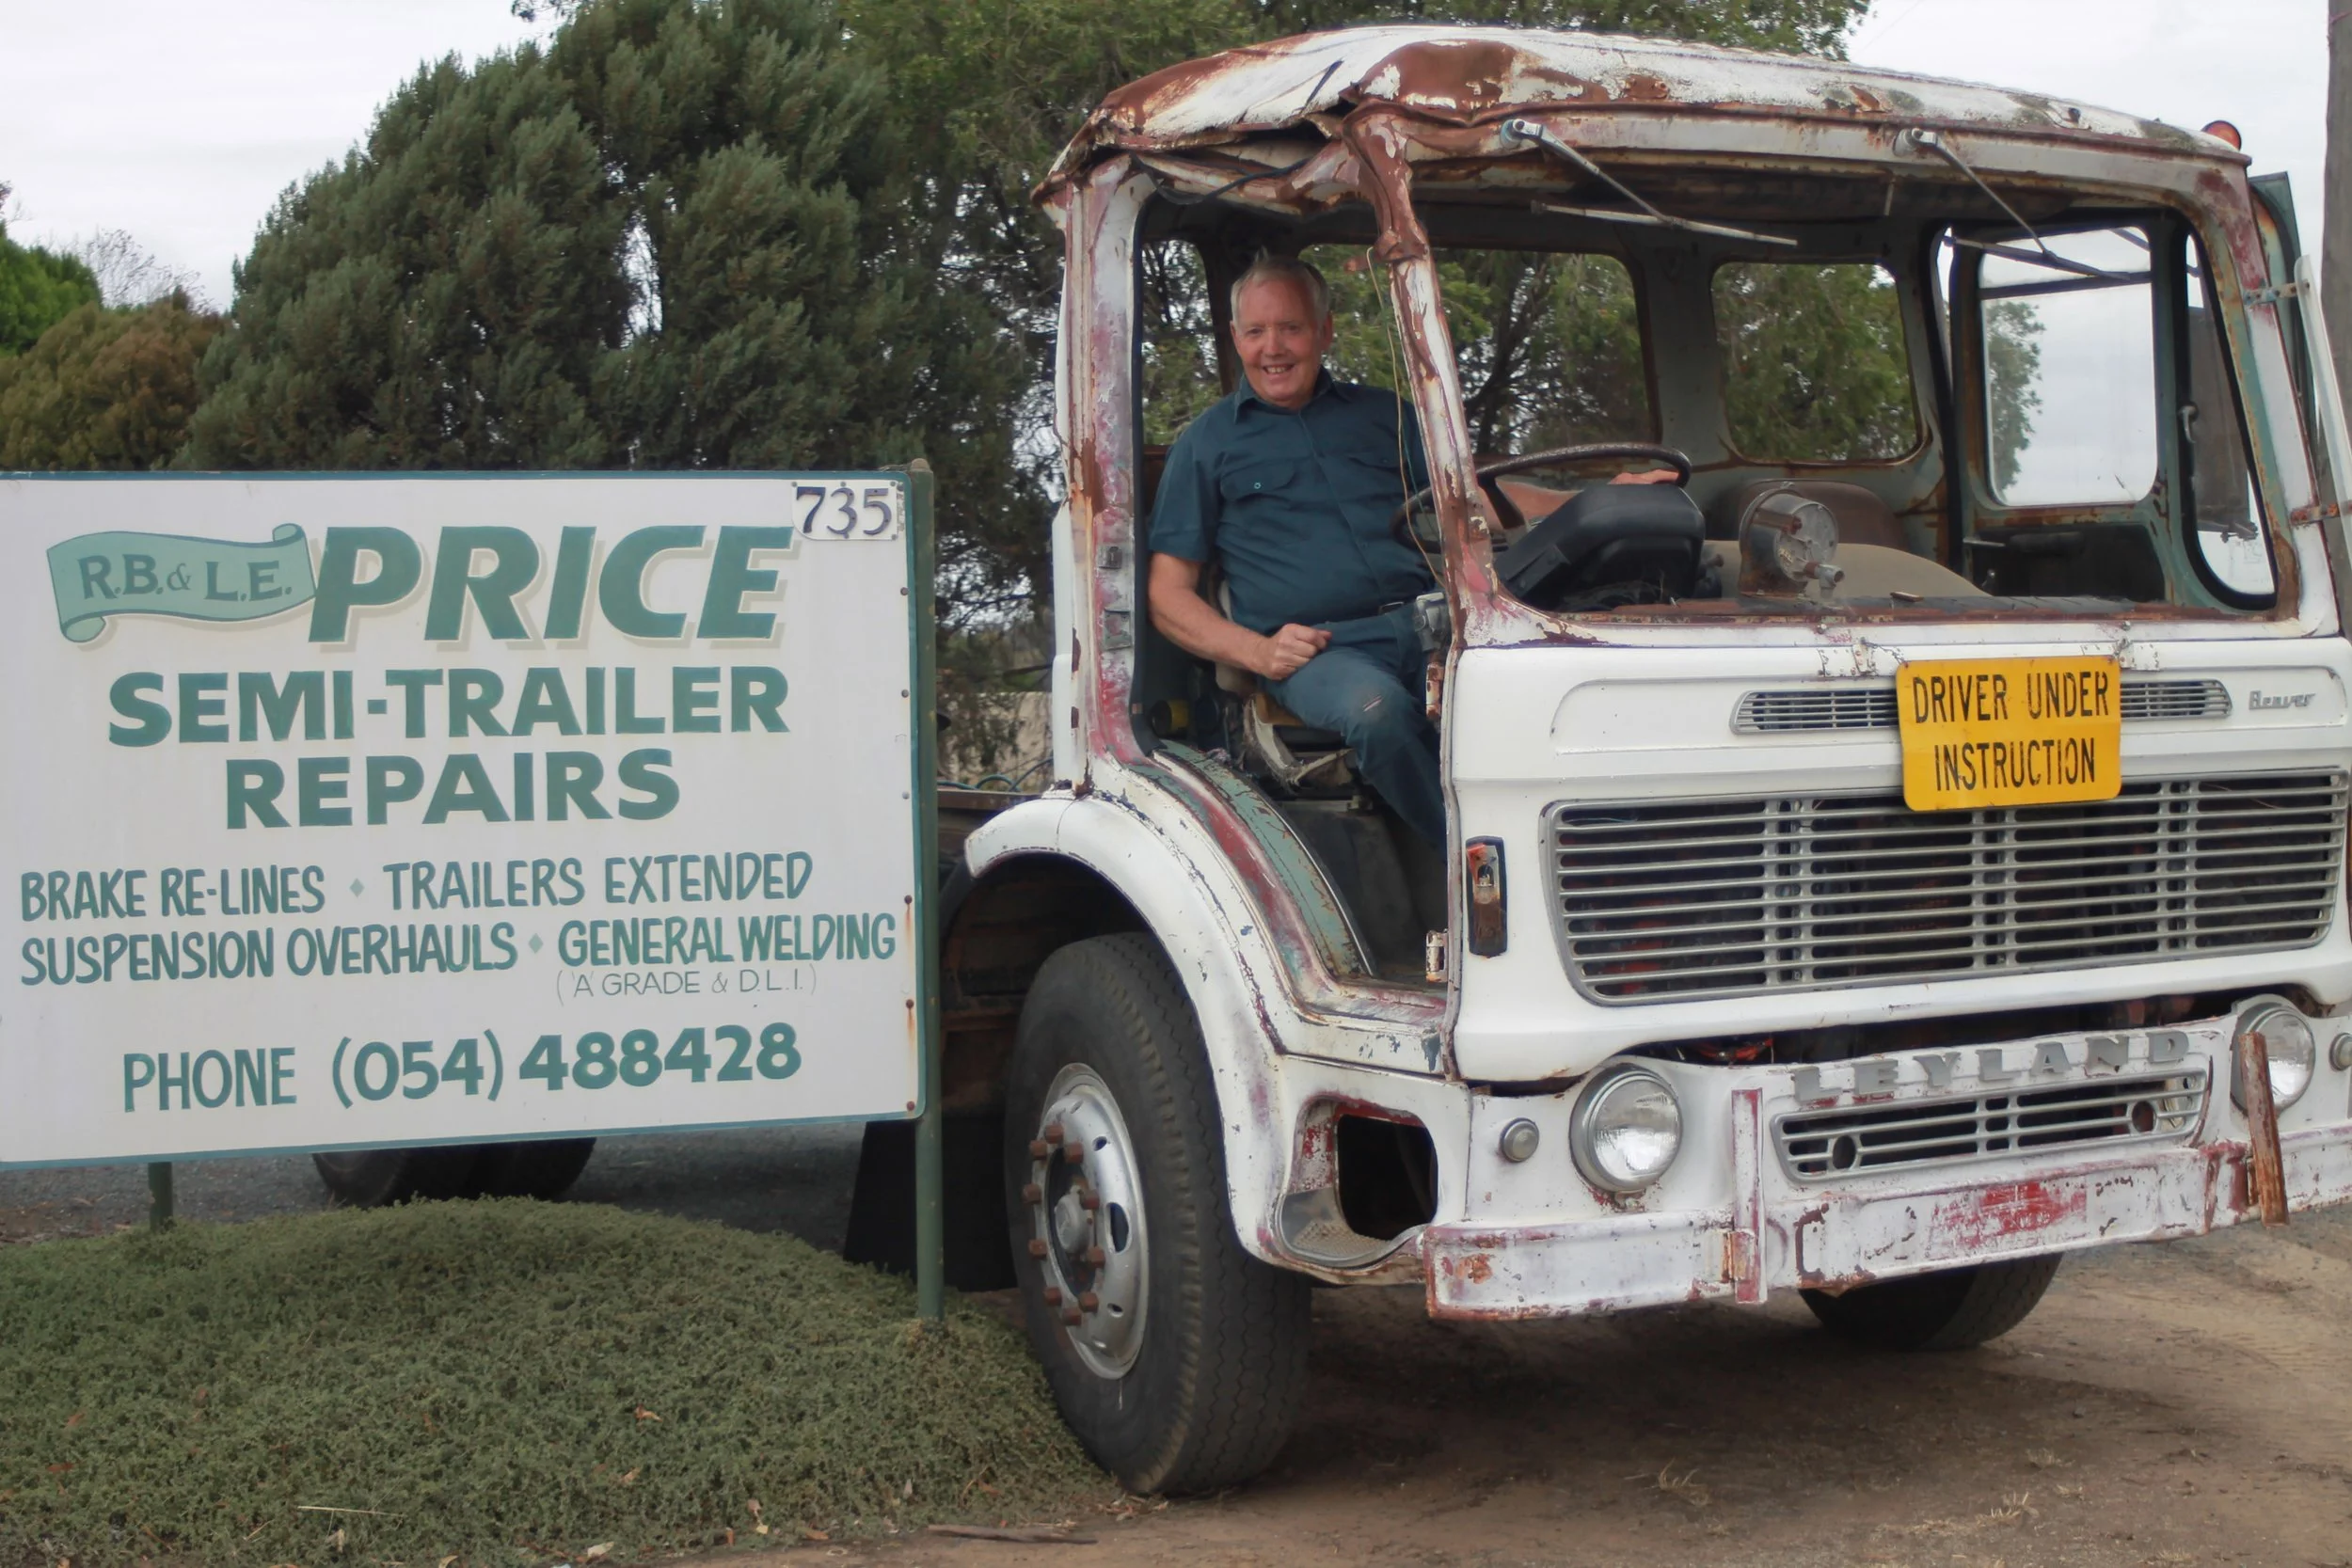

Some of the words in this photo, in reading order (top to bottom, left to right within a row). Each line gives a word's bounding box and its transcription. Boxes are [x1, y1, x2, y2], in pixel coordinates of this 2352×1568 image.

[796, 486, 892, 537] 735
[78, 553, 164, 599] R.B.
[203, 560, 293, 602] L.E.
[309, 525, 795, 643] PRICE
[108, 665, 791, 748] SEMI-TRAILER
[1913, 673, 2009, 724] DRIVER
[2026, 671, 2109, 720] UNDER
[226, 748, 680, 830] REPAIRS
[1934, 736, 2096, 792] INSTRUCTION
[21, 868, 147, 921] BRAKE
[160, 864, 326, 916] RE-LINES
[383, 857, 585, 910] TRAILERS
[604, 851, 813, 905] EXTENDED
[21, 927, 275, 986] SUSPENSION
[286, 922, 518, 976] OVERHAULS
[558, 916, 735, 967] GENERAL
[738, 912, 897, 961] WELDING
[601, 971, 700, 996] GRADE
[711, 972, 728, 993] &
[123, 1047, 297, 1113] PHONE
[332, 1028, 503, 1109] (054)
[519, 1022, 802, 1091] 488428
[1790, 1030, 2189, 1103] LEYLAND
